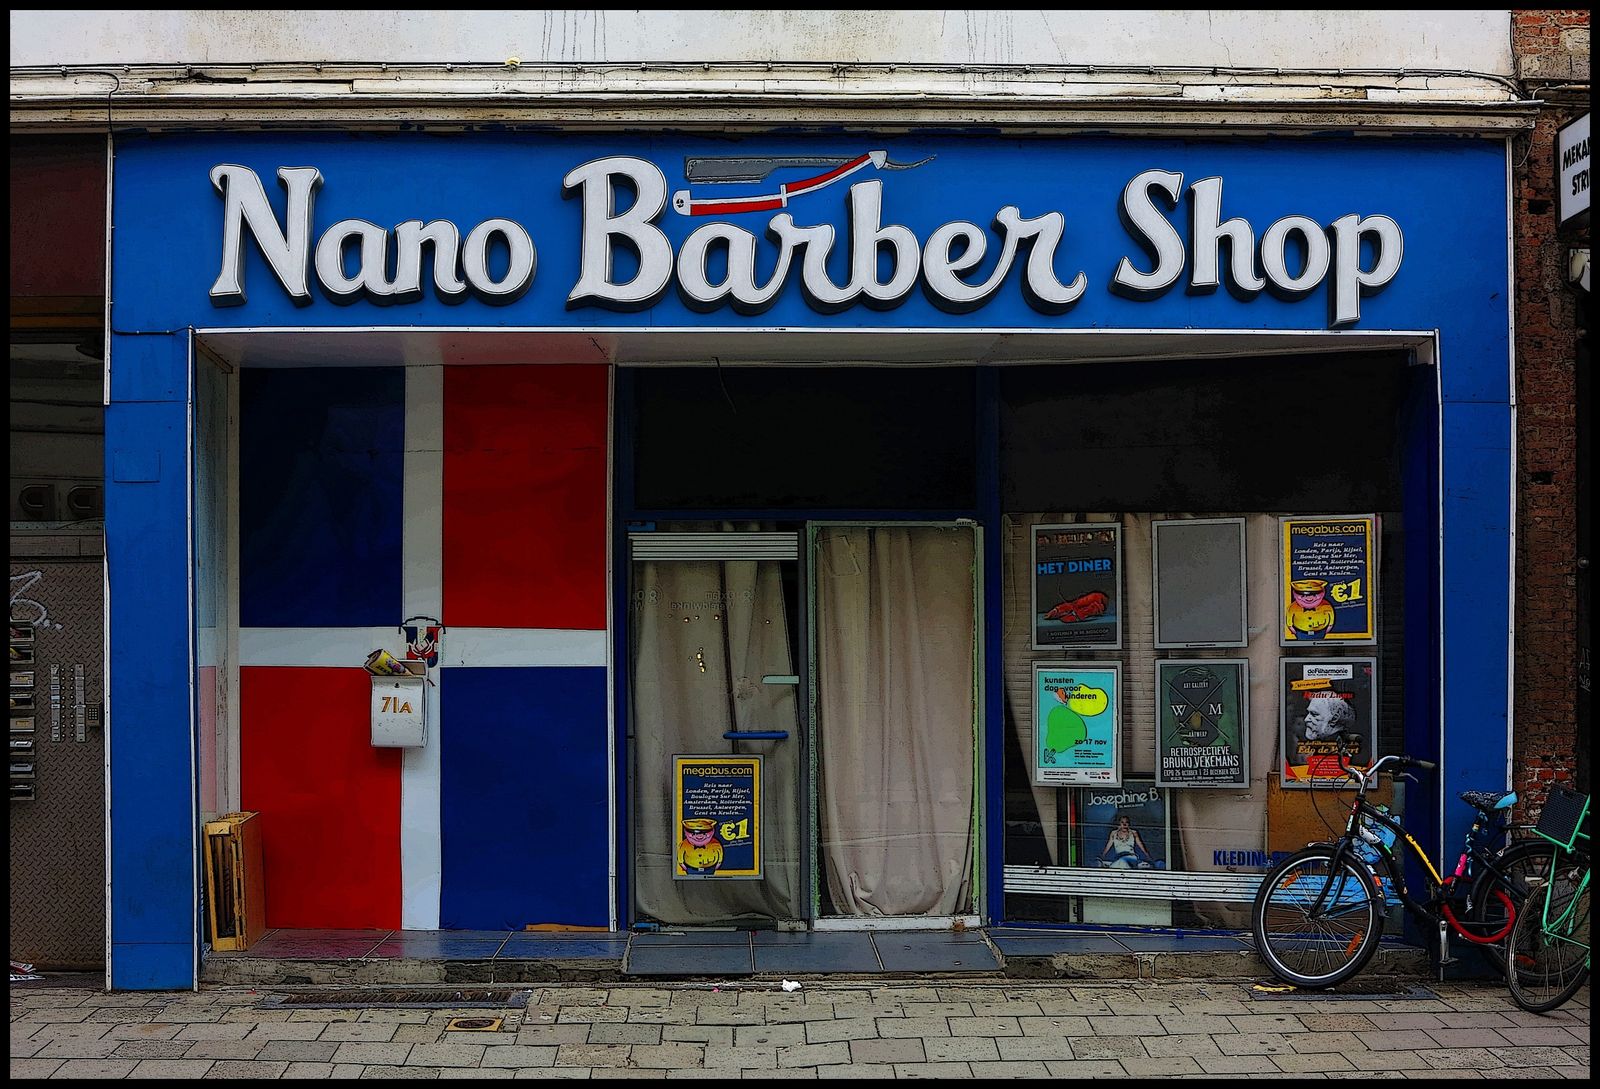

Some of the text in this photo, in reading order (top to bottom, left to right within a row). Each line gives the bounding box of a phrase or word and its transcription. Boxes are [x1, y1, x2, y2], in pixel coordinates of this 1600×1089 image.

[1572, 168, 1590, 196] STRI
[209, 155, 1404, 325] Nano Barber Shop
[1291, 524, 1365, 536] megabus.com
[1037, 559, 1112, 575] HET DINER
[1331, 578, 1363, 603] €1
[1065, 692, 1097, 700] kinderen
[381, 696, 412, 714] 71A
[1170, 704, 1187, 716] W
[1208, 703, 1223, 716] M
[1170, 746, 1230, 757] RETROSPECTIEVE
[1163, 756, 1239, 769] BRUNO VEKEMANS
[683, 766, 752, 777] megabus.com
[1088, 789, 1148, 809] Josephine
[1149, 787, 1161, 801] B.
[720, 818, 750, 841] €1
[1213, 850, 1270, 866] KLEDIN
